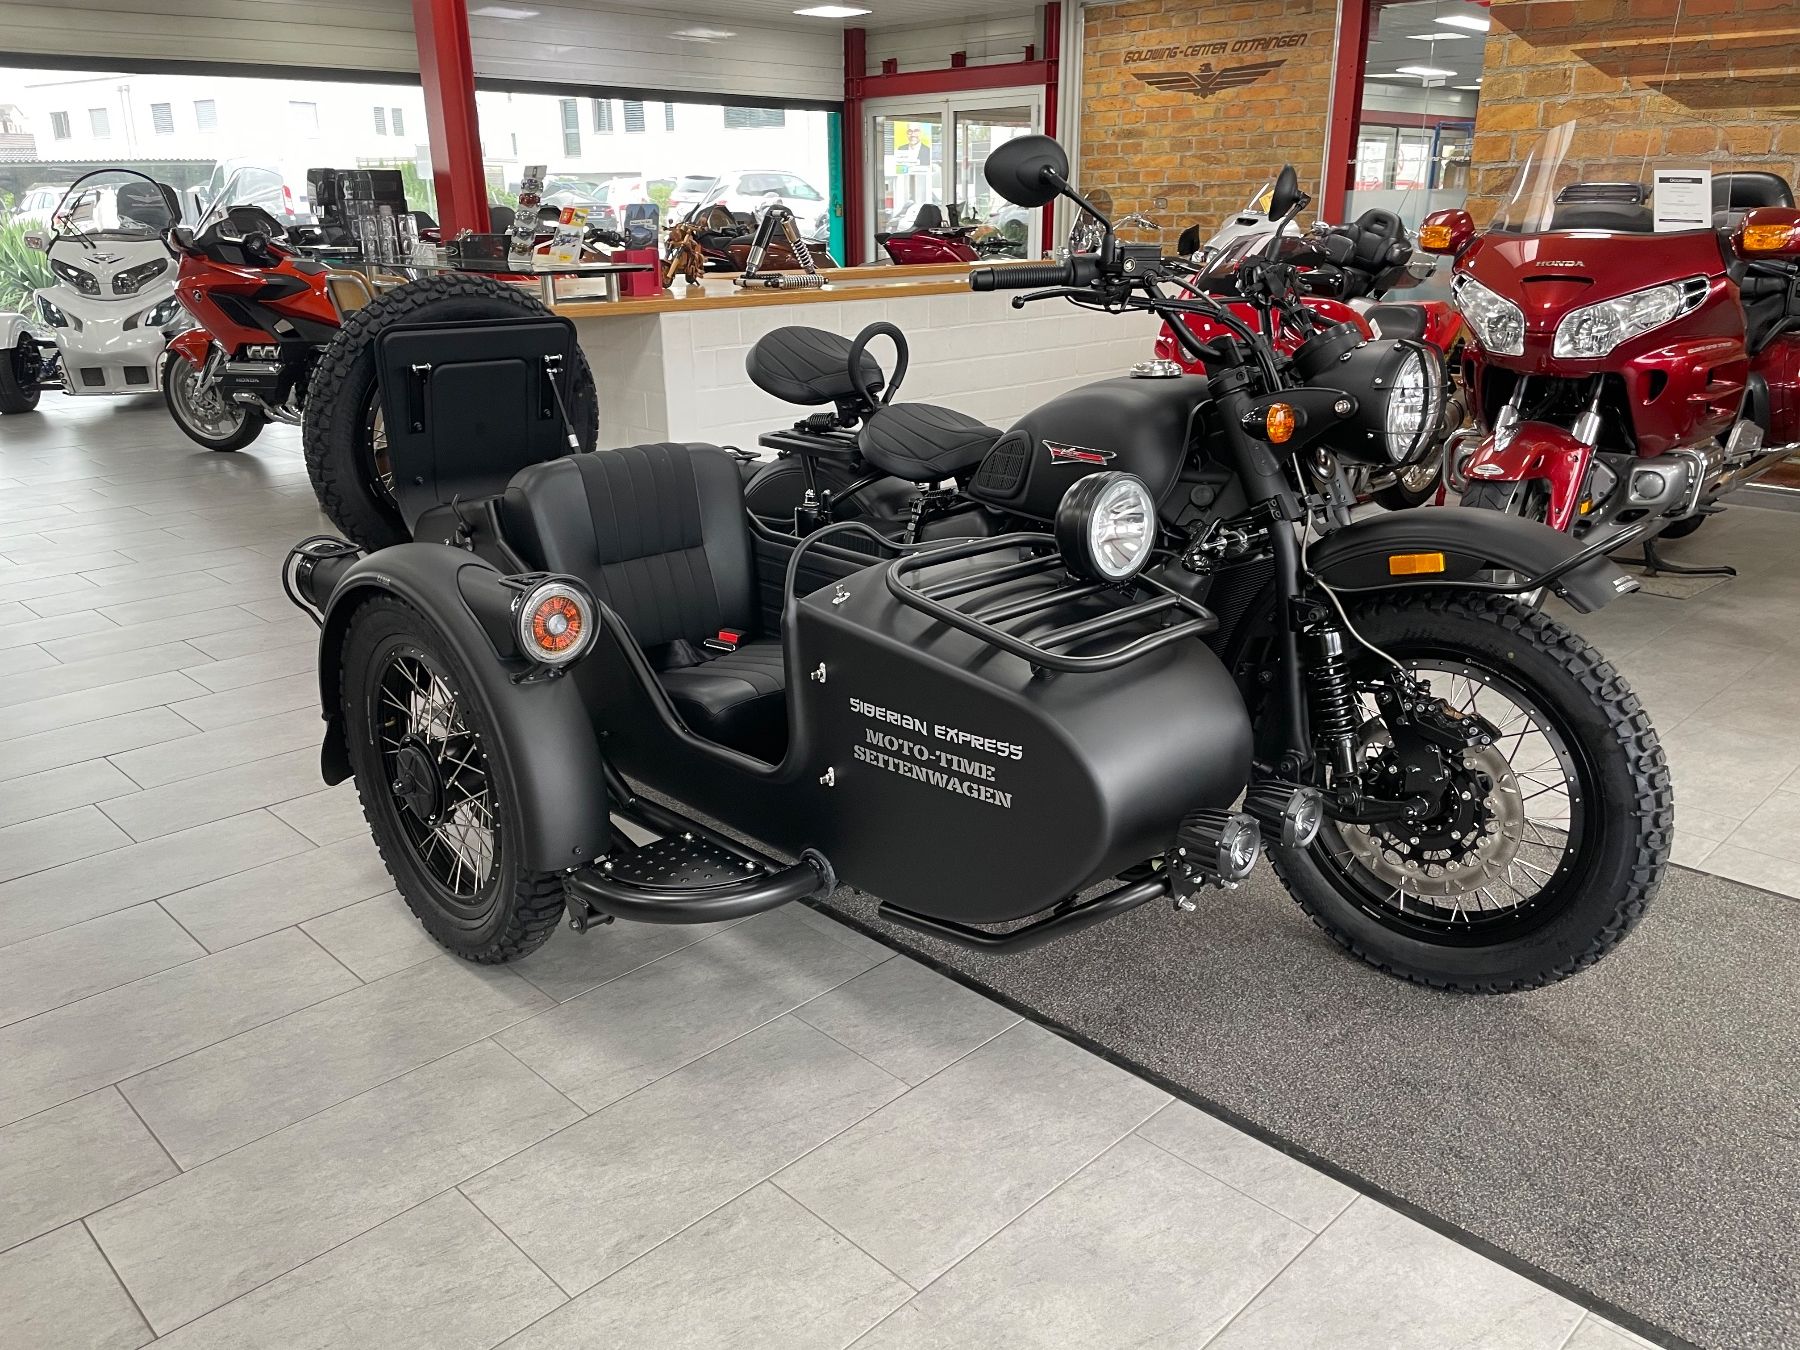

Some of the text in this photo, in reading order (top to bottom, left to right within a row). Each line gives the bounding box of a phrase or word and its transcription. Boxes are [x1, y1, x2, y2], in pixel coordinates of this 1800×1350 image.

[849, 697, 1023, 760] SIBERIAN EXPRESS
[865, 727, 996, 782] MOTO-TIME
[853, 743, 1013, 809] SEITENWAGEN
